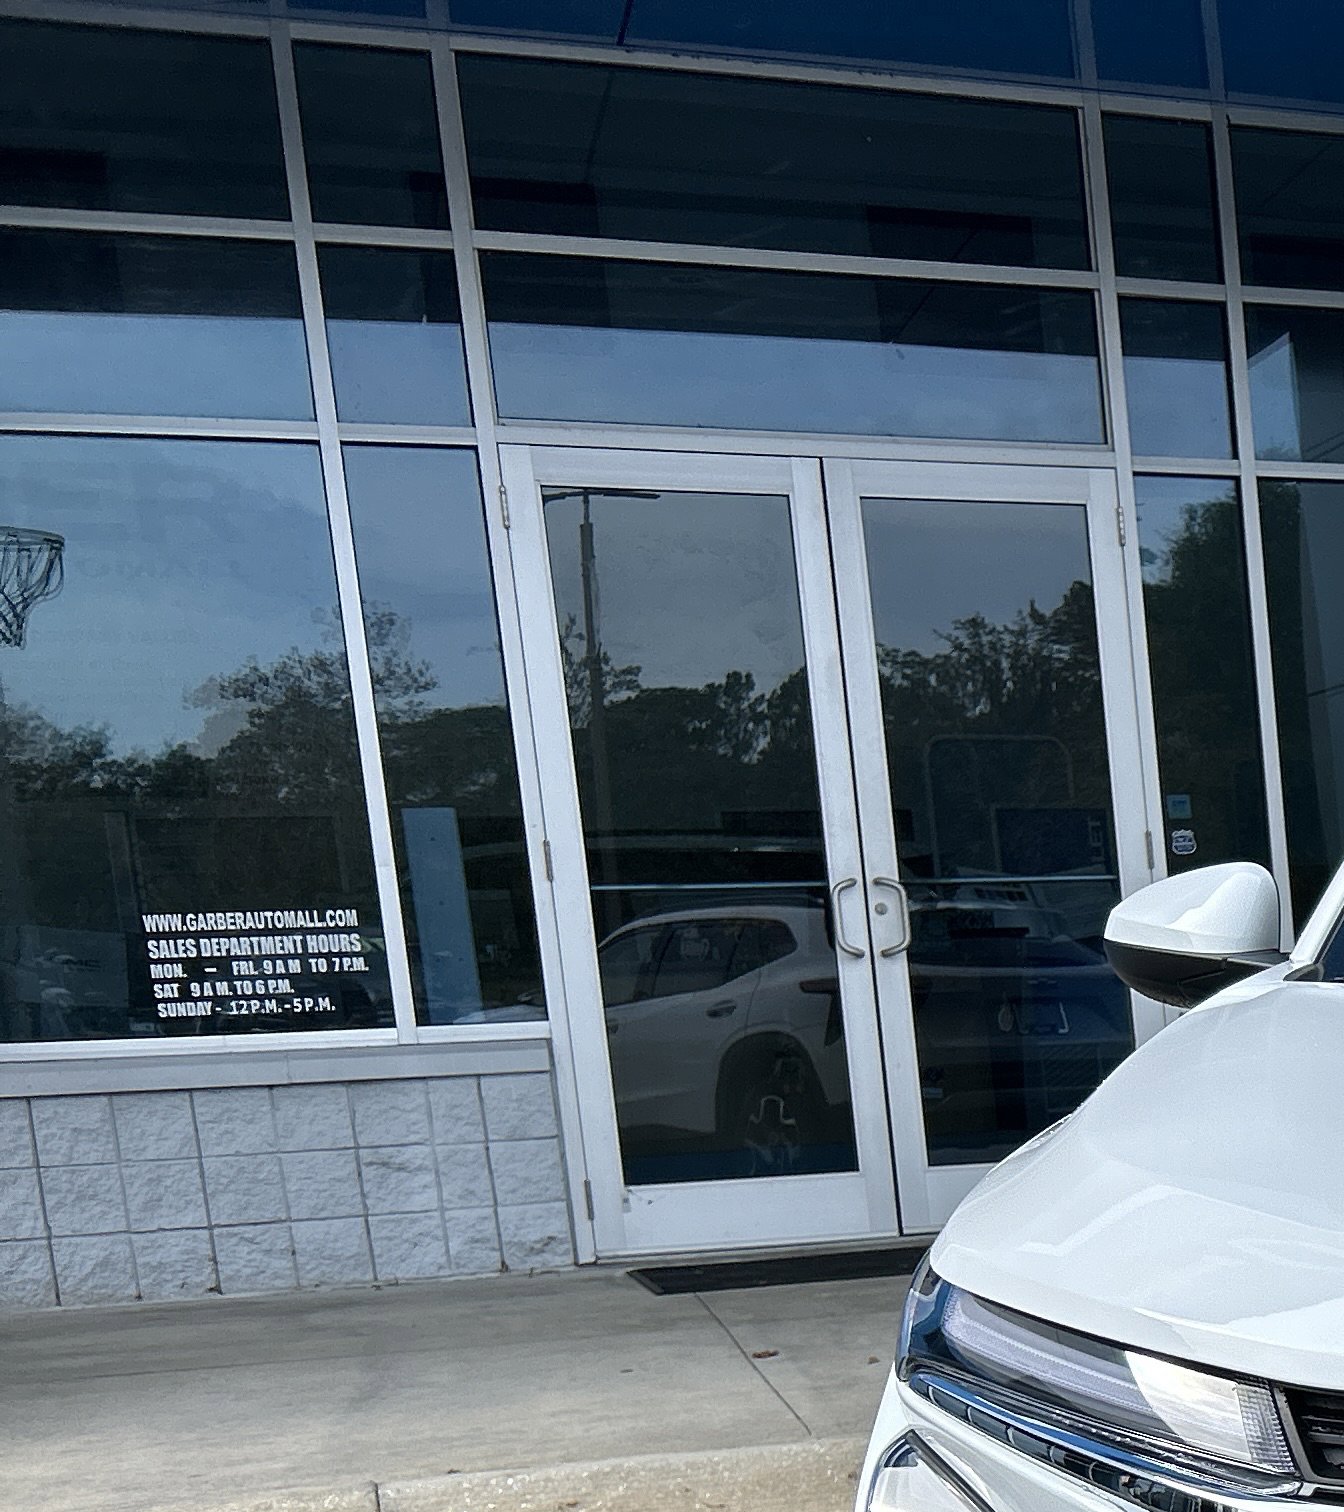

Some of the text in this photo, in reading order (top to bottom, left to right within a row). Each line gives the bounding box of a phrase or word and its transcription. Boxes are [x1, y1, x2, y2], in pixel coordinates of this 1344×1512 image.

[142, 909, 359, 933] WWW.GARBERAUTOMALL.COM
[147, 932, 362, 959] SALES DEPARTMENT HOURS
[149, 963, 188, 979] MON.
[308, 957, 328, 973] TO
[153, 983, 180, 999] SAT
[233, 980, 253, 996] TO
[157, 1001, 213, 1018] SUNDAY
